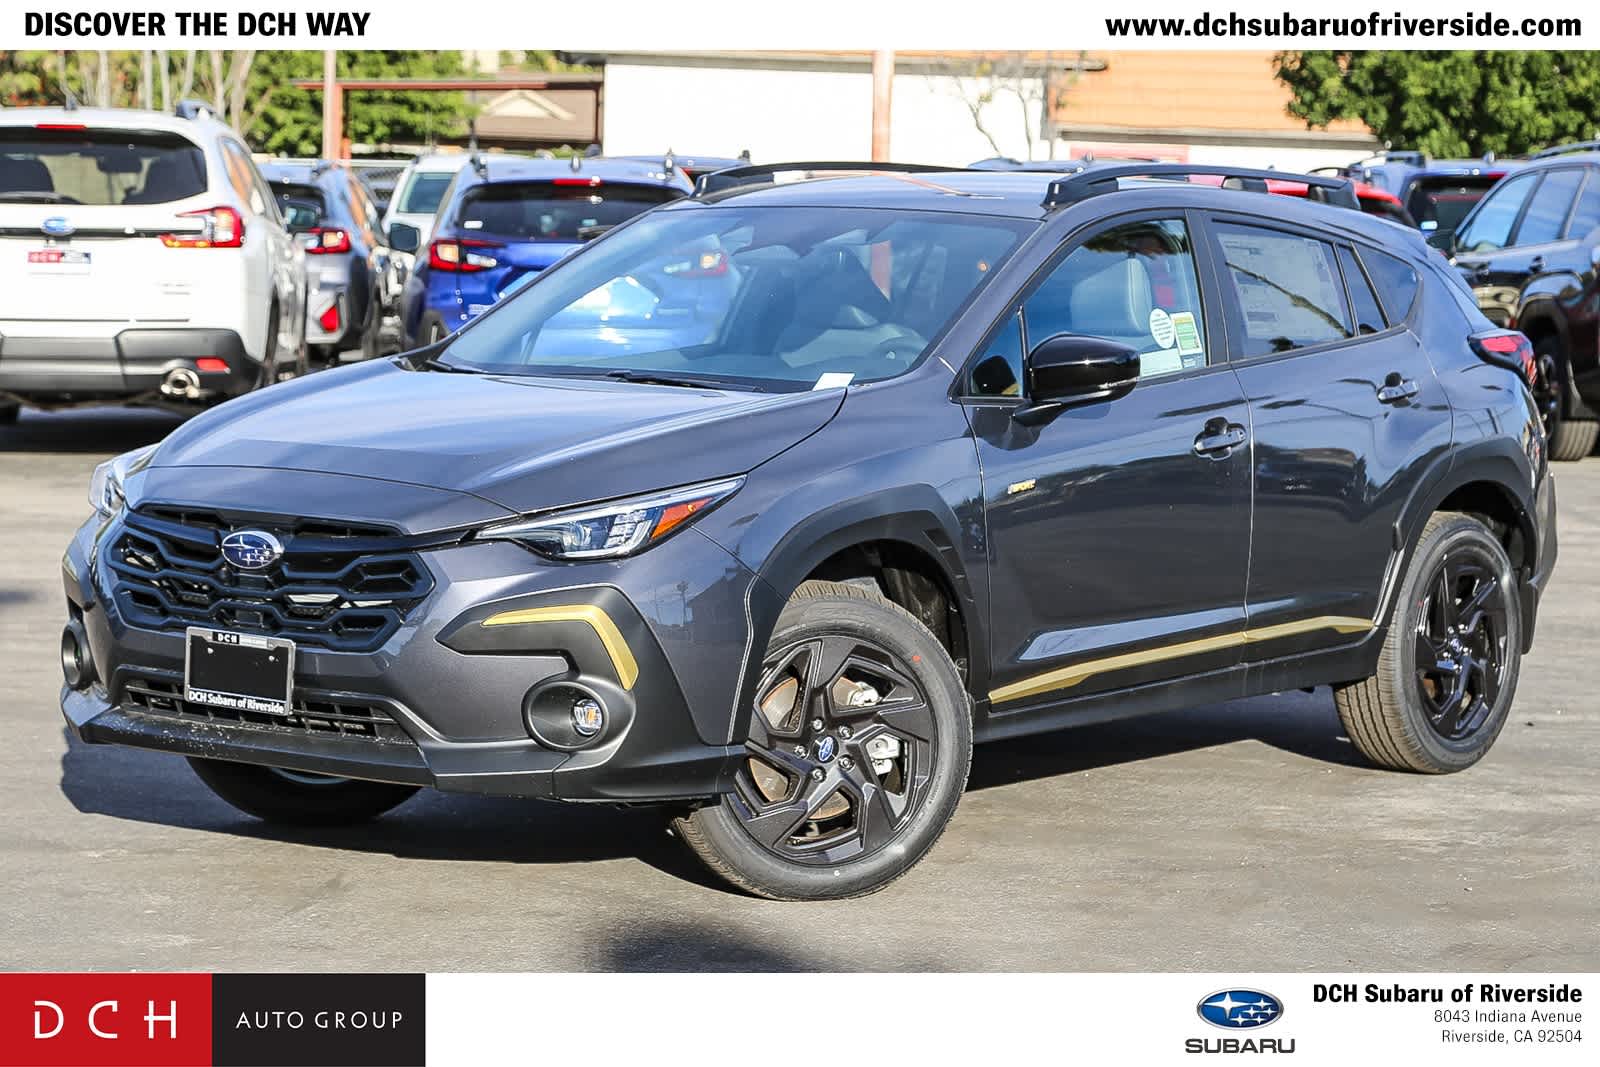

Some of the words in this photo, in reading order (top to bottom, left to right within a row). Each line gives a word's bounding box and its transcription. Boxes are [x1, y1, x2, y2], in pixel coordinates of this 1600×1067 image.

[217, 633, 238, 644] DCH
[188, 690, 208, 703] DCH
[207, 693, 237, 707] Subaru
[237, 698, 246, 709] of
[246, 699, 285, 714] Riverside
